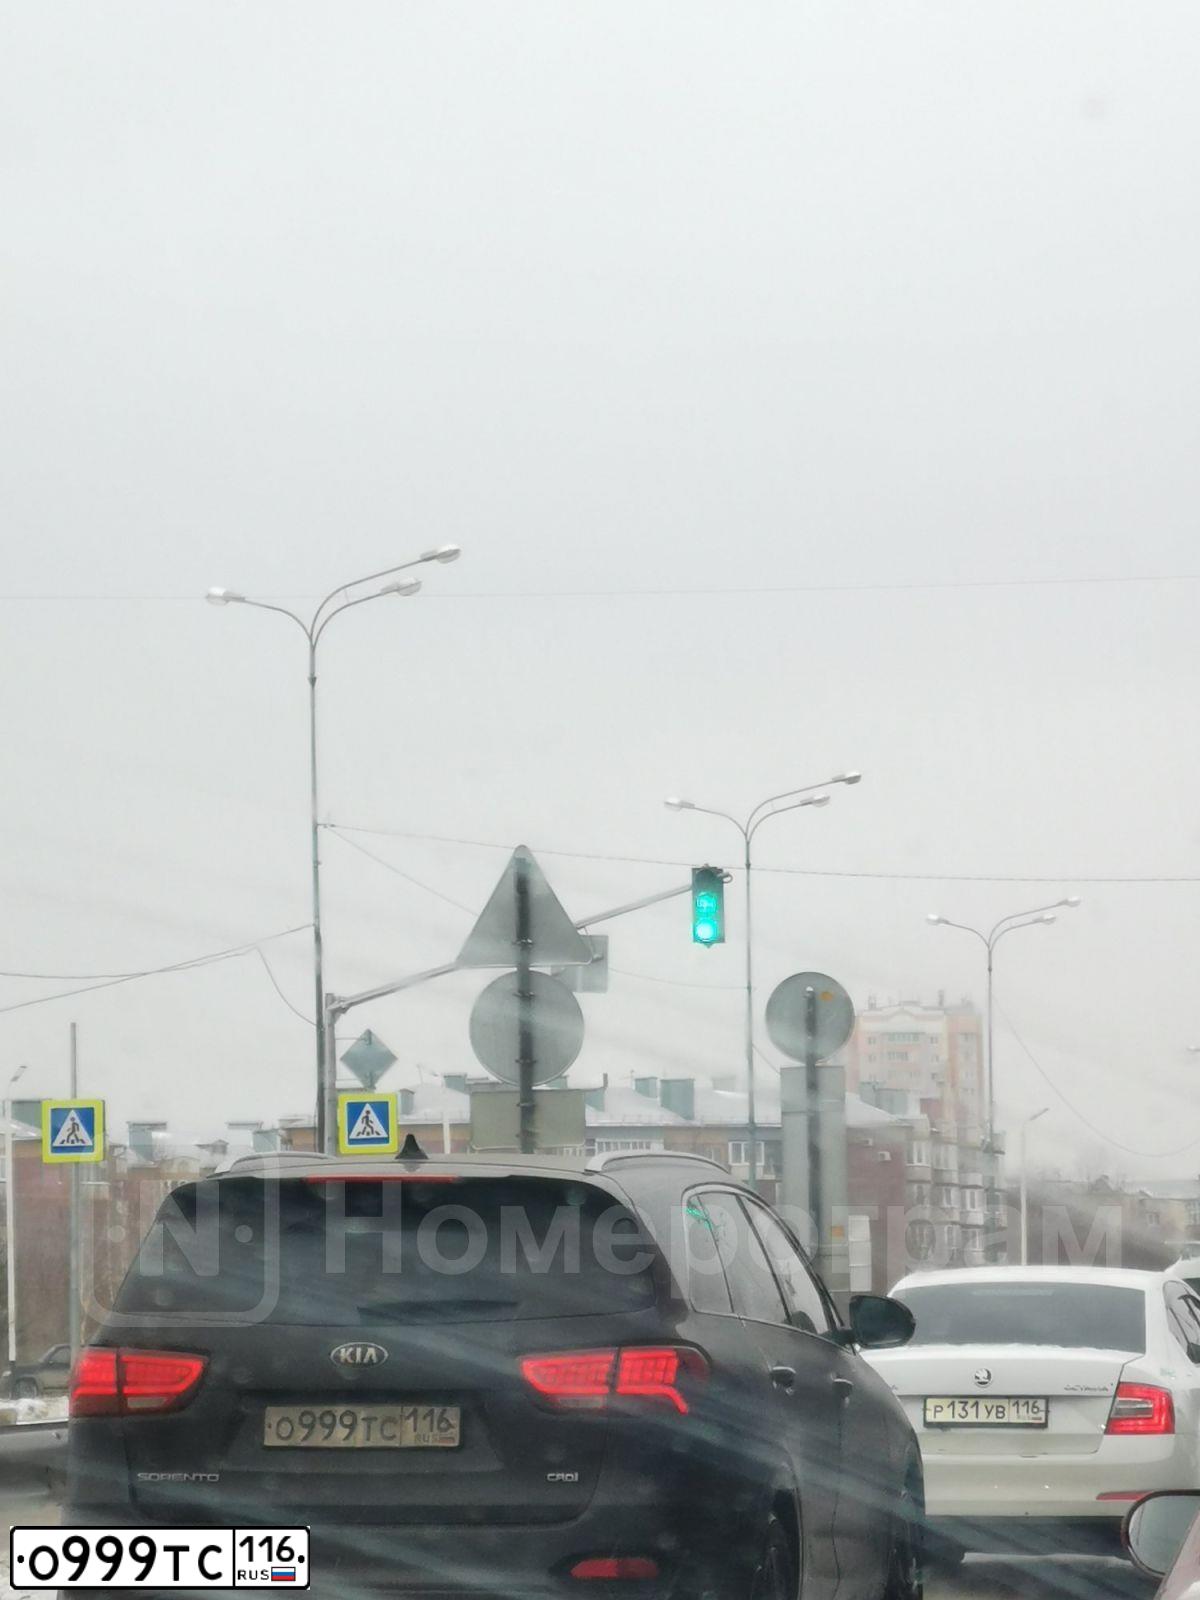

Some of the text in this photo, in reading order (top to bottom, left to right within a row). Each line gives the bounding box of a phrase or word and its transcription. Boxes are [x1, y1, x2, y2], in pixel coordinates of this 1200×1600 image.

[339, 1347, 378, 1364] KIA
[1012, 1399, 1041, 1415] 116
[402, 1407, 451, 1433] 116
[137, 1472, 220, 1482] SORENTO
